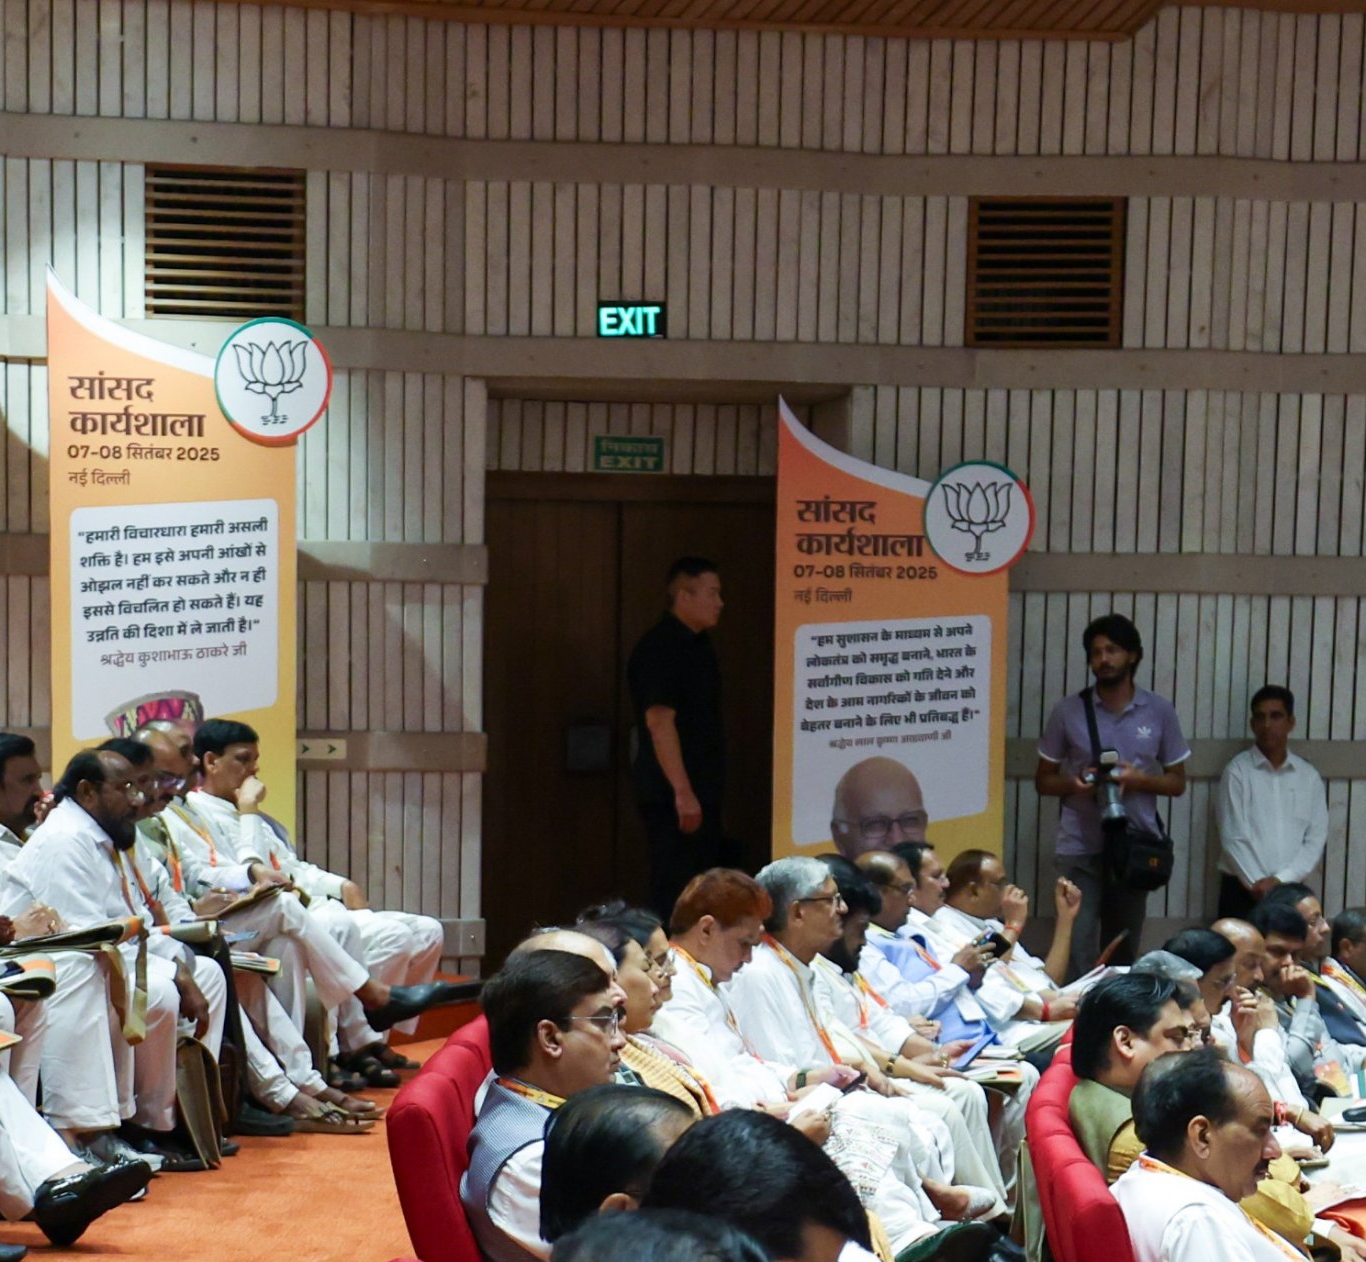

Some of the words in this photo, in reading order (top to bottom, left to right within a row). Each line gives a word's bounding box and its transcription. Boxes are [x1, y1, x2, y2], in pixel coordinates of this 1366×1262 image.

[599, 306, 661, 336] EXIT
[68, 371, 155, 402] सांसद
[69, 405, 206, 438] कार्यशाला
[67, 444, 122, 459] 07-08
[126, 443, 172, 461] सितंबर
[176, 447, 220, 461] 2025
[600, 456, 658, 469] EXIT
[69, 468, 87, 487] नई
[92, 469, 130, 485] दिल्ली
[796, 495, 876, 524] सांसद
[124, 525, 186, 540] विचारधारा
[190, 520, 224, 537] हमारी
[229, 517, 268, 533] असली
[80, 552, 110, 568] शक्ति
[133, 552, 151, 567] हम
[155, 548, 174, 565] इसे
[179, 545, 214, 561] अपनी
[218, 542, 252, 559] आंखों
[255, 542, 266, 557] से
[796, 527, 925, 557] कार्यशाला
[81, 577, 122, 594] ओझल
[127, 574, 151, 590] नहीं
[153, 576, 172, 588] कर
[176, 570, 210, 586] सकते
[214, 568, 236, 584] और
[240, 571, 249, 582] न
[253, 566, 266, 583] ही
[794, 565, 845, 579] 07-08
[850, 564, 892, 580] सितंबर
[896, 566, 938, 580] 2025
[83, 601, 114, 620] इससे
[118, 599, 169, 615] विचलित
[173, 596, 186, 613] हो
[189, 594, 223, 610] सकते
[244, 594, 264, 607] यह
[794, 588, 812, 604] नई
[816, 589, 853, 604] दिल्ली
[87, 626, 119, 643] उन्नति
[123, 624, 140, 639] की
[144, 623, 174, 638] दिशा
[177, 620, 187, 636] में
[191, 620, 202, 635] ले
[206, 618, 235, 633] जाती
[100, 650, 134, 668] श्रद्धेय
[138, 648, 193, 668] कुशाभाऊ
[196, 643, 228, 659] ठाकरे
[232, 640, 247, 656] जी
